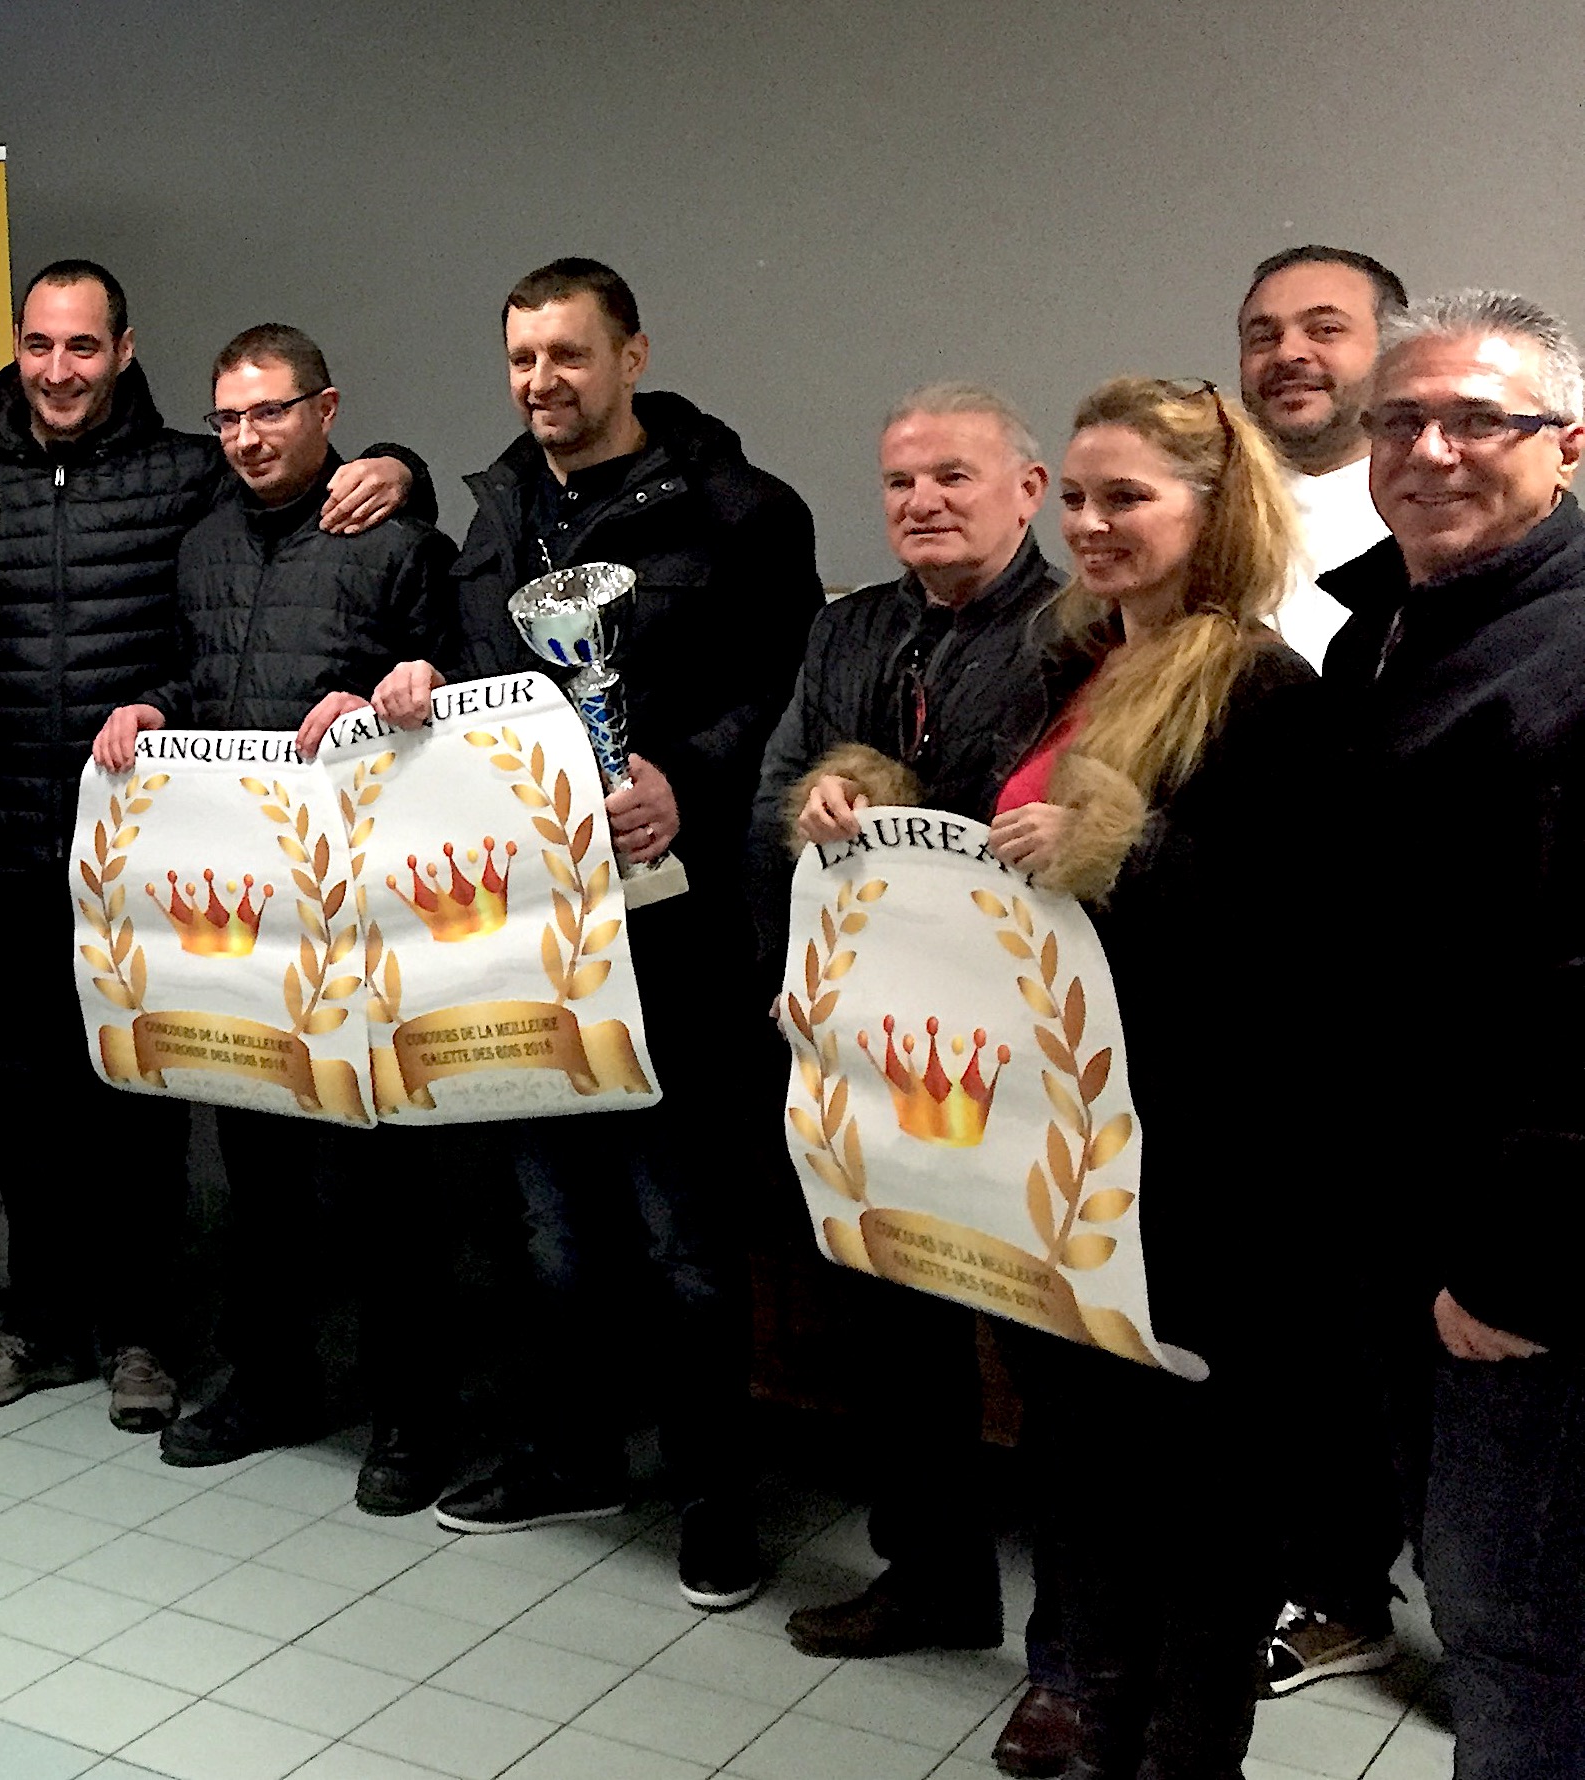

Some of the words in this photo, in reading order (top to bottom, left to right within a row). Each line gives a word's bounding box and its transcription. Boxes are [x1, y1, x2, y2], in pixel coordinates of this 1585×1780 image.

[330, 679, 535, 748] VAIUEUR
[135, 736, 304, 764] AINQUEUR
[815, 817, 1035, 889] LAUREA
[145, 1021, 198, 1040] CONCOURS
[199, 1029, 213, 1042] DE
[215, 1030, 230, 1044] LA
[233, 1033, 294, 1053] MEILLEURE
[405, 1028, 459, 1046] CONCOURS
[460, 1026, 475, 1041] DE
[477, 1024, 493, 1039] LA
[495, 1016, 559, 1036] MEILLEURE
[420, 1048, 471, 1066] GALETTE
[472, 1046, 495, 1061] DES
